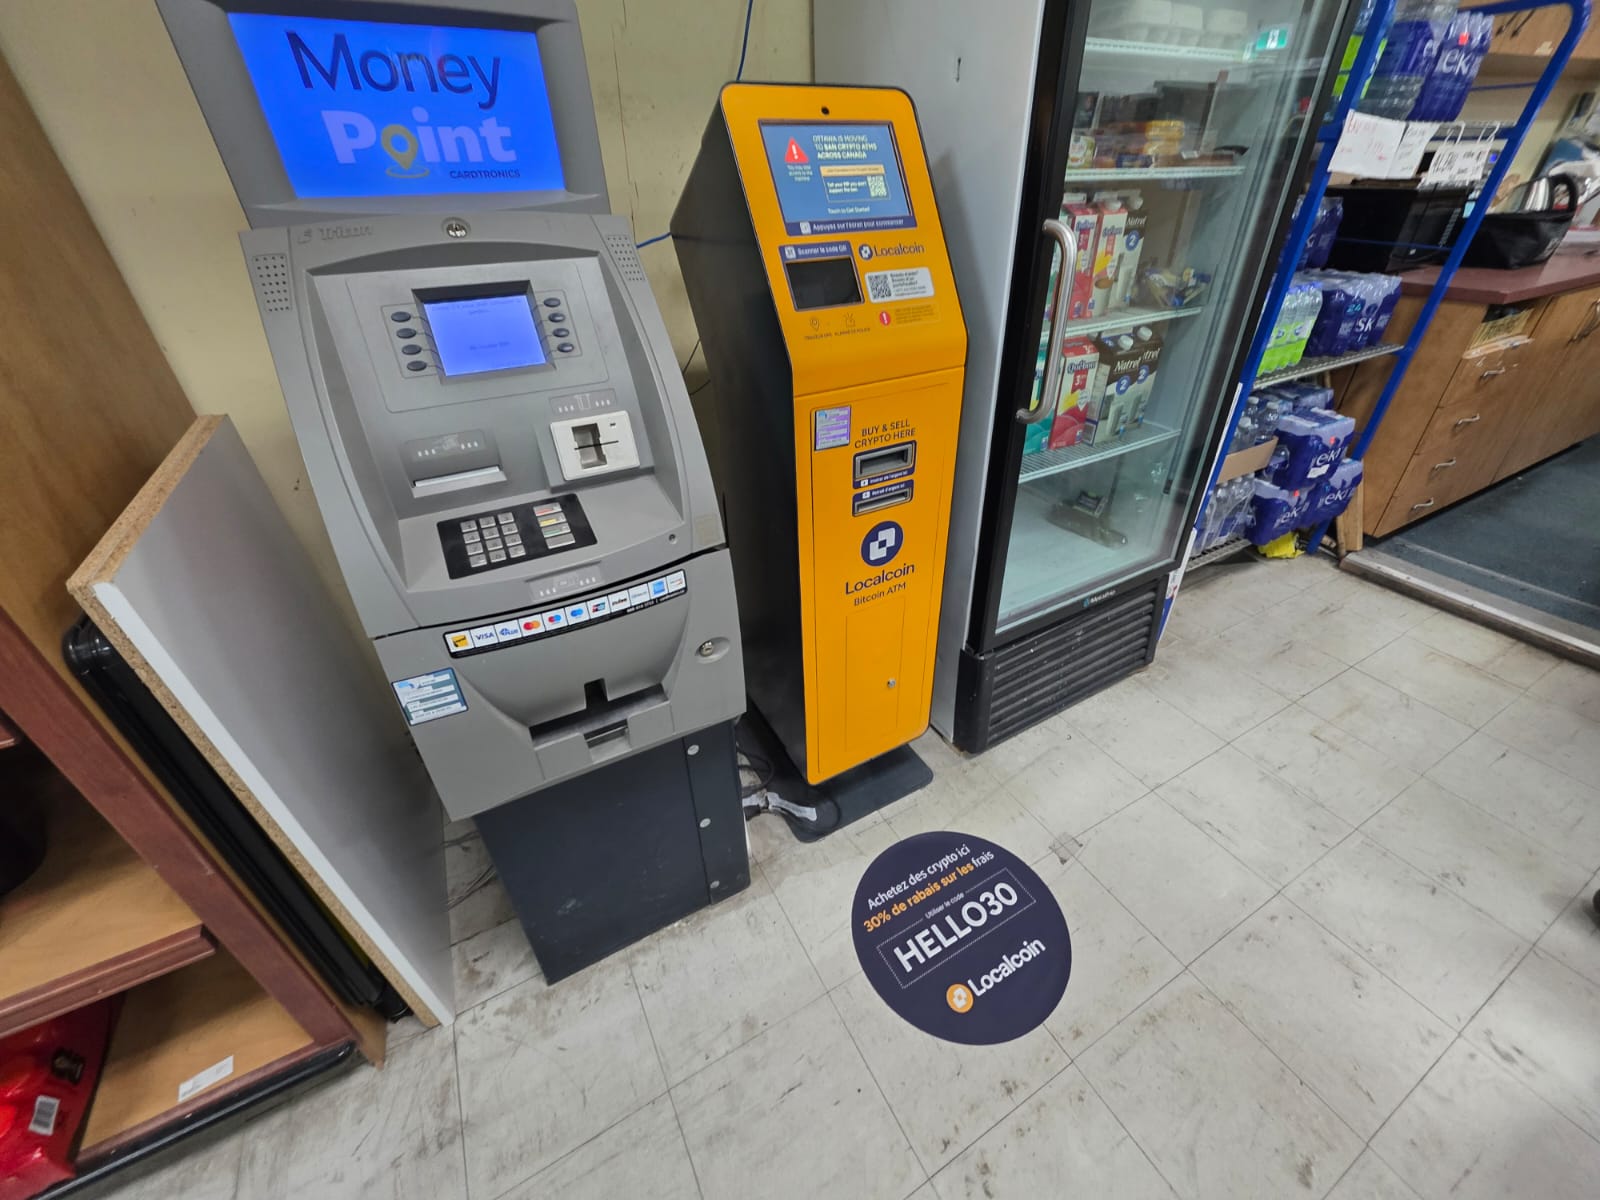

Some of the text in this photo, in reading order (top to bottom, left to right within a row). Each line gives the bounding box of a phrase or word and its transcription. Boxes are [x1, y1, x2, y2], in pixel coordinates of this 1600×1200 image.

[285, 31, 500, 110] Money
[320, 106, 517, 172] Point
[817, 151, 841, 159] ACROSS
[449, 169, 521, 180] CARDTRONICS
[873, 242, 925, 257] Localcoin
[1114, 357, 1140, 373] Natrel
[854, 427, 916, 449] CRYPTO HERE
[861, 418, 910, 437] BUY & SELL
[845, 563, 915, 595] Localcoin
[854, 581, 906, 606] Bitcoin ATM
[475, 631, 494, 641] VISA
[867, 843, 971, 911] Achetez des crypto ici
[863, 850, 995, 933] 30% de rabais sur les frais
[949, 892, 965, 905] code
[893, 882, 1018, 973] HELLO30
[967, 938, 1047, 997] Localcoin
